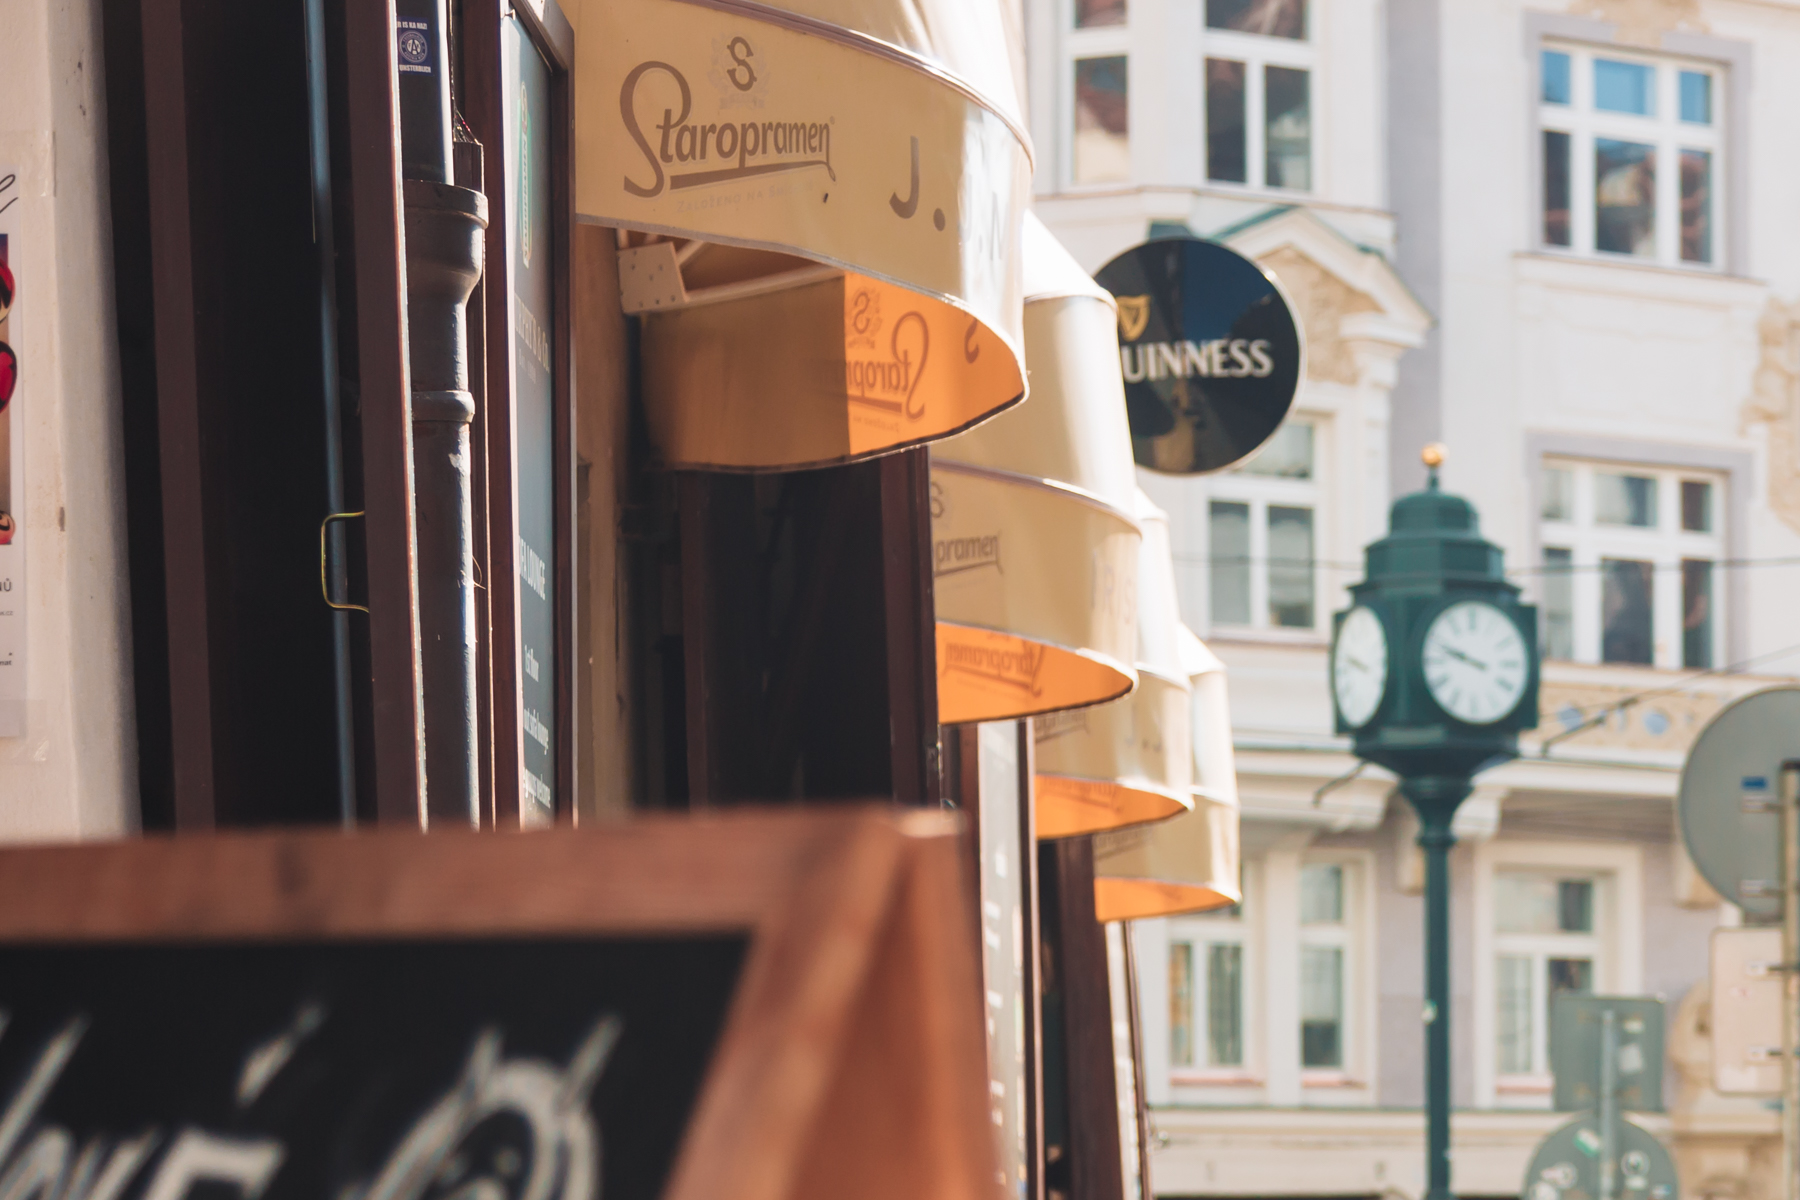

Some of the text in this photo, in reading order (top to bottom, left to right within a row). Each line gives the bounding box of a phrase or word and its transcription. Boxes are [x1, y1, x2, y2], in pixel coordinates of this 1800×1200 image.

[620, 61, 836, 198] Staropramen
[1121, 338, 1274, 384] UINNESS
[935, 532, 1003, 578] pramen
